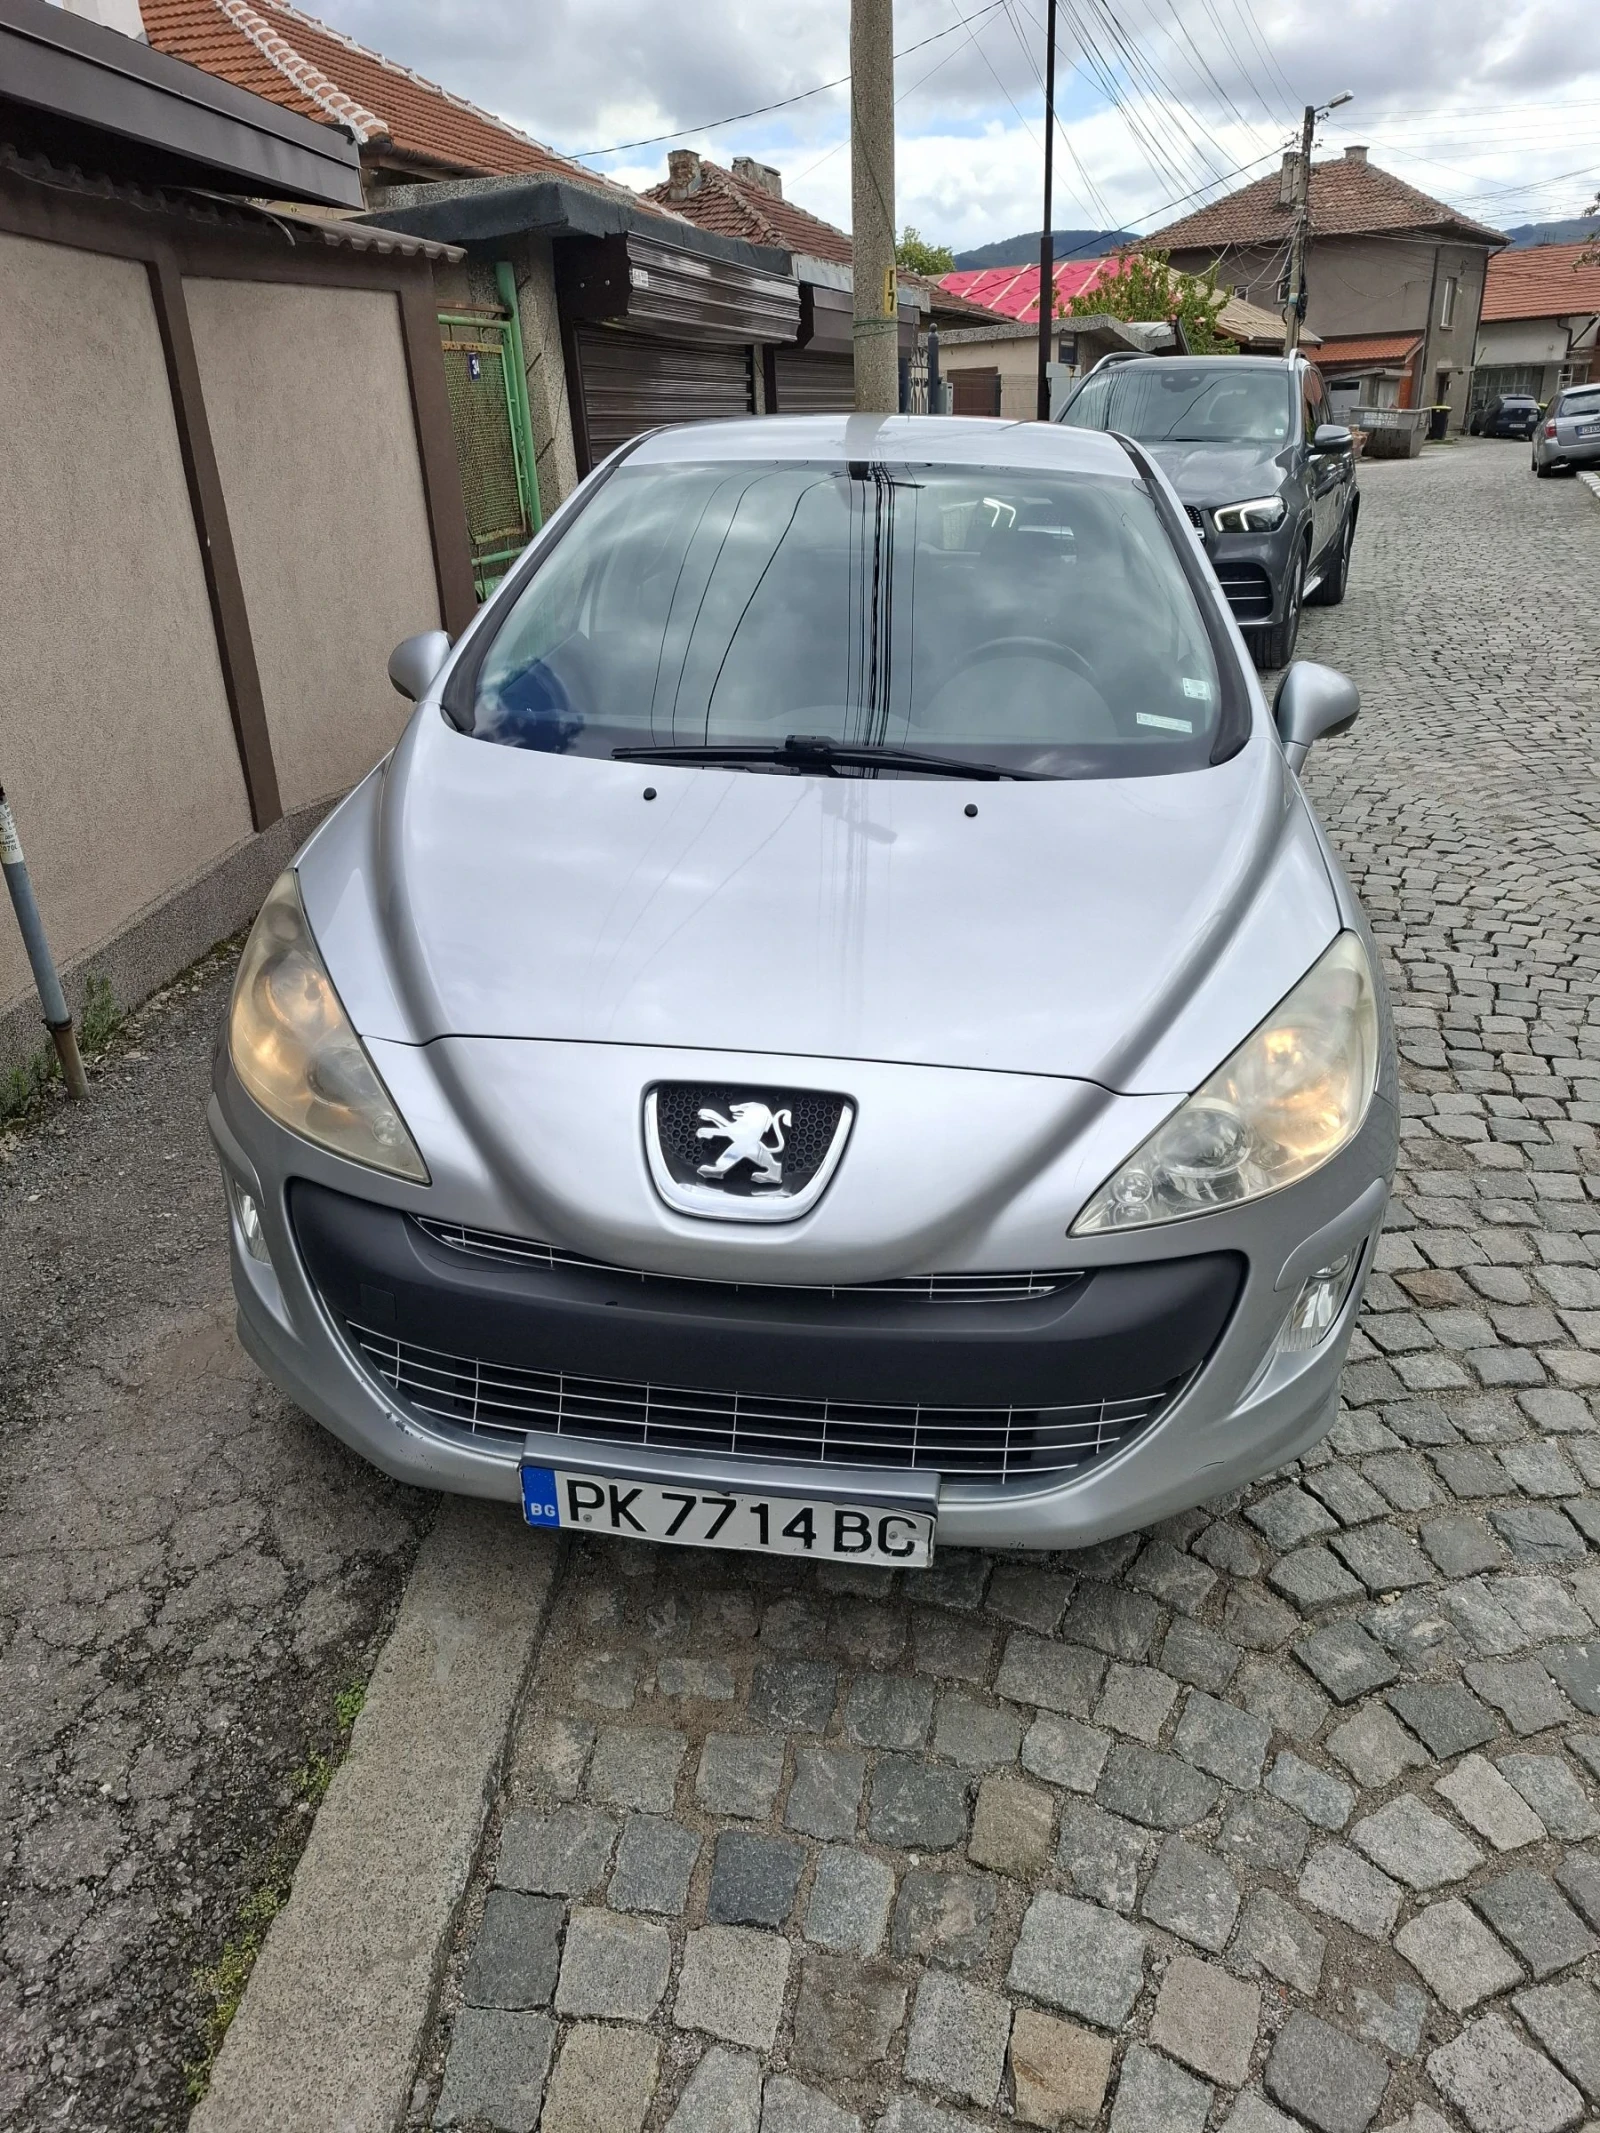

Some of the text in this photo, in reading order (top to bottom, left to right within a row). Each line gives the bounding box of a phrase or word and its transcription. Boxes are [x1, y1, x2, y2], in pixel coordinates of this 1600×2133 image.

[530, 1502, 556, 1518] BG
[566, 1479, 918, 1558] PK 7714 BC
